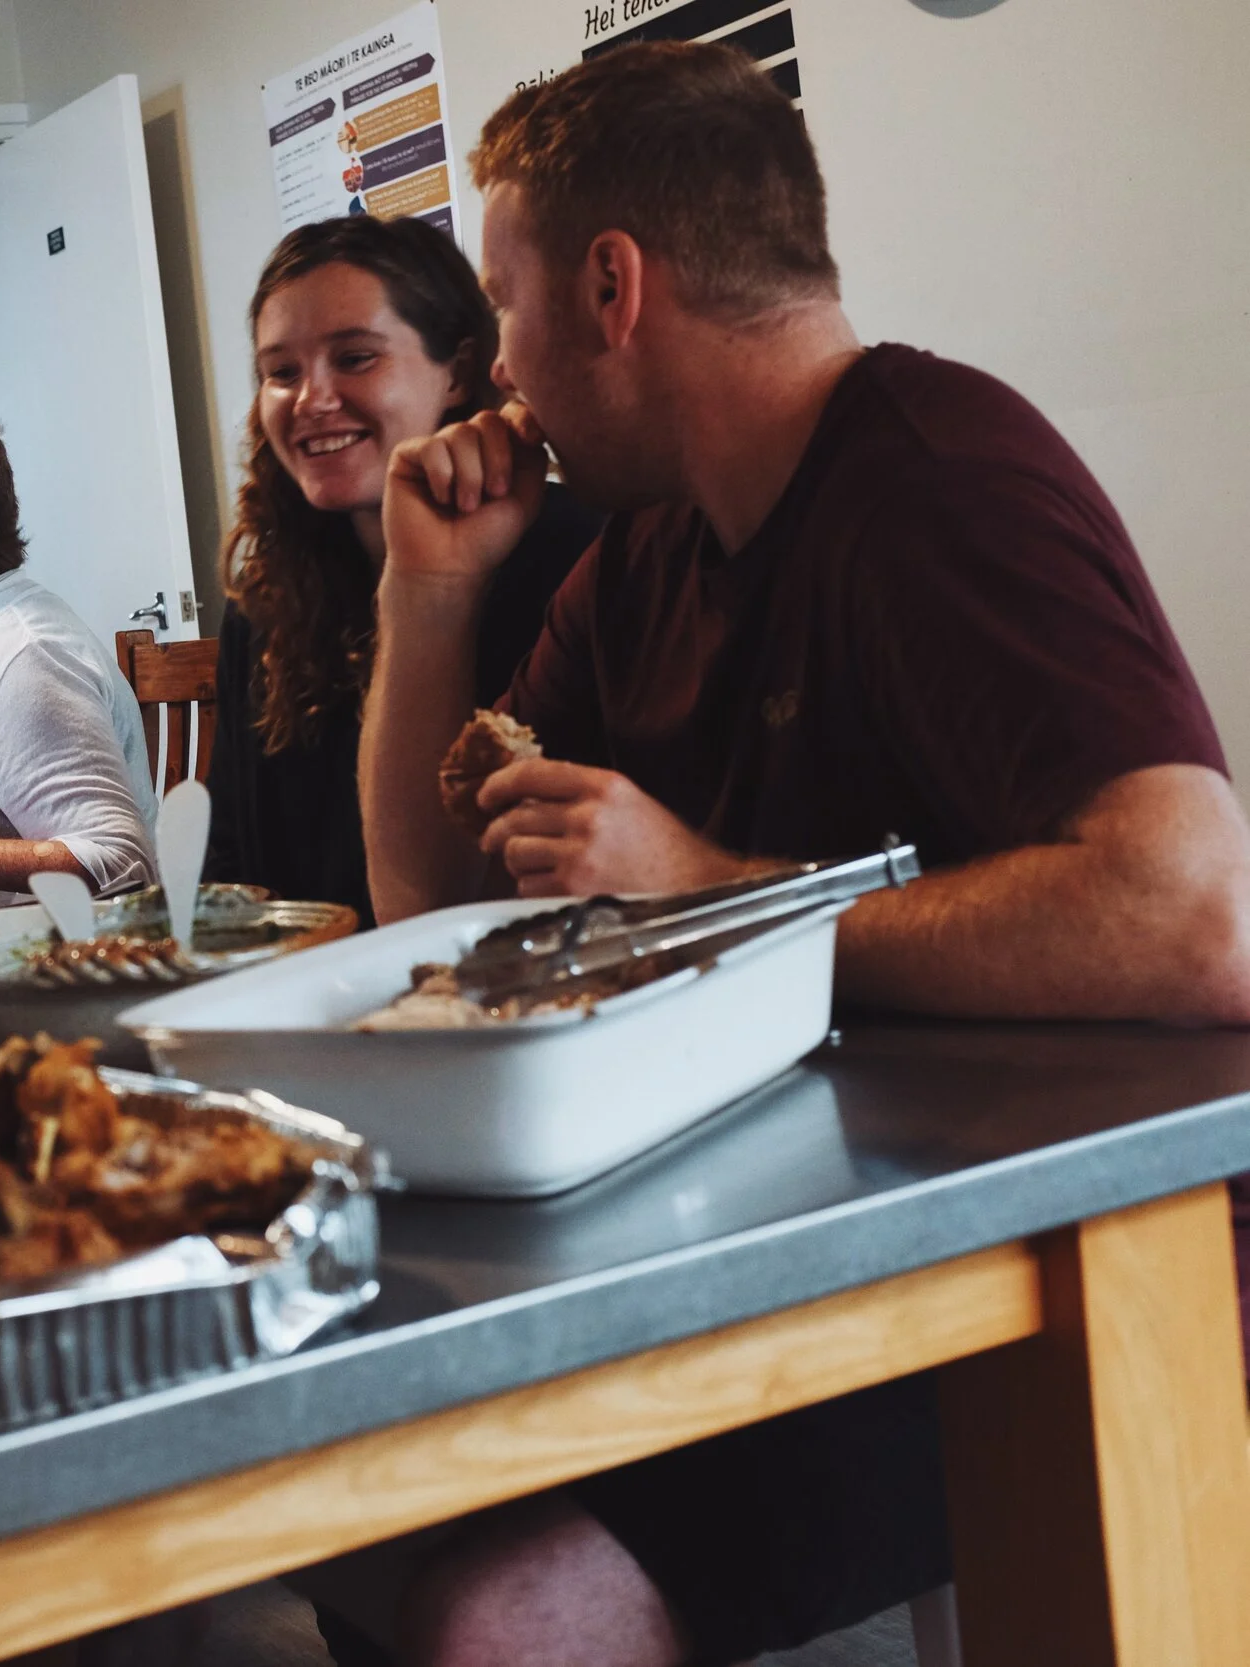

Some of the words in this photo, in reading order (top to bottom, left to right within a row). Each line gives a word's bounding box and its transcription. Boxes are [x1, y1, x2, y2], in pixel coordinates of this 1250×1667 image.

[584, 0, 615, 39] Hei
[295, 78, 303, 92] TE
[304, 70, 319, 87] REO
[351, 48, 360, 63] TE
